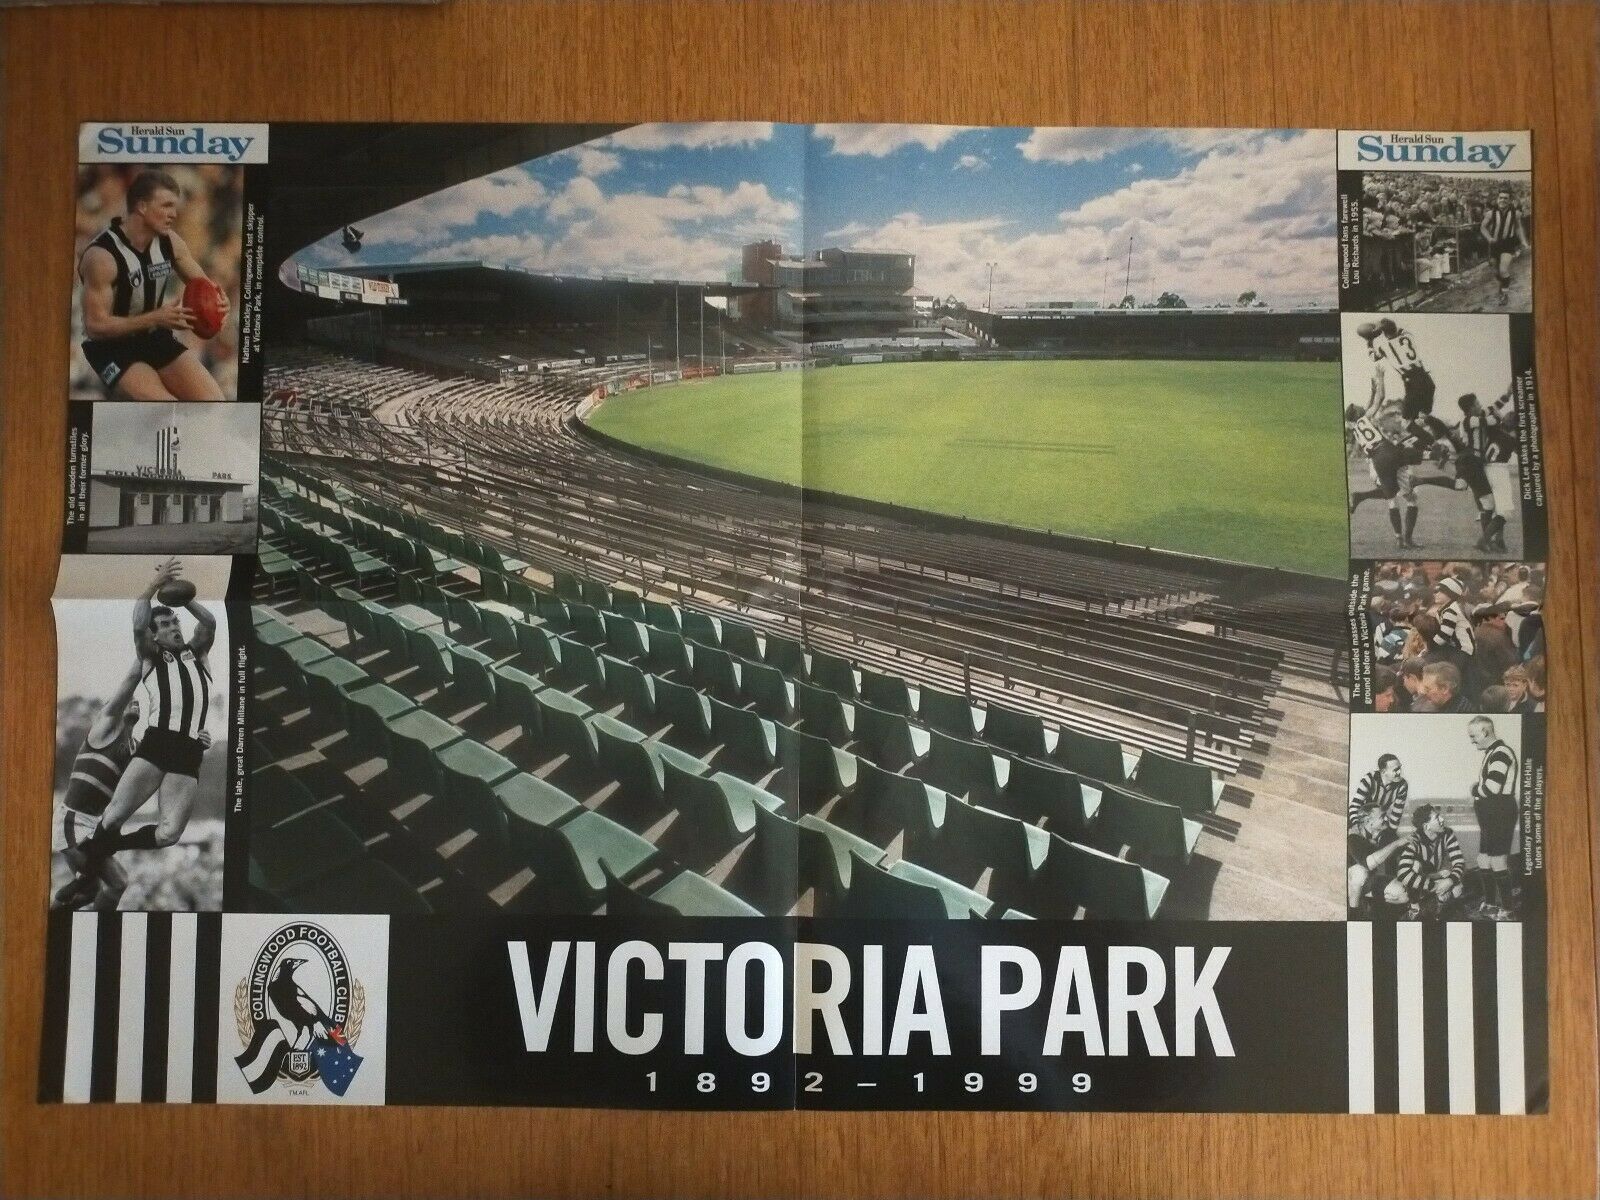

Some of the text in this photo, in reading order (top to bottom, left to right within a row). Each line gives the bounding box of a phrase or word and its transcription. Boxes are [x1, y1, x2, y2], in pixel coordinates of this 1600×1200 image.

[131, 126, 185, 136] Herald Sun
[1390, 134, 1444, 144] Herald Sun
[97, 127, 255, 162] Sunday
[1357, 135, 1516, 170] Sunday
[246, 203, 255, 230] skipper
[244, 249, 254, 299] Collingwood's
[255, 246, 264, 280] complete
[1341, 244, 1350, 289] Collingwood
[254, 292, 262, 311] Park,
[243, 302, 252, 333] Buckley,
[242, 336, 250, 364] Nathan
[1387, 335, 1417, 366] 13
[1525, 368, 1533, 390] 1914.
[1516, 376, 1525, 410] screamer
[1528, 403, 1540, 452] photographer
[69, 427, 78, 463] turnstiles
[80, 432, 89, 452] glory.
[79, 455, 87, 479] former
[1532, 462, 1539, 470] by
[1524, 483, 1532, 500] Dick
[1533, 473, 1543, 506] captured
[67, 510, 75, 525] The
[78, 513, 85, 521] in
[1362, 568, 1370, 591] game.
[1358, 594, 1368, 611] Park
[1348, 574, 1360, 698] The crowded masses outside the
[1358, 613, 1369, 640] Victoria
[238, 645, 247, 668] flight.
[238, 670, 246, 684] full
[1363, 677, 1372, 704] ground
[237, 696, 245, 725] Millane
[236, 727, 245, 753] Darren
[236, 755, 244, 776] great
[1524, 758, 1532, 788] McHale
[235, 778, 244, 795] late,
[1523, 790, 1532, 808] Jock
[234, 798, 242, 812] The
[1524, 835, 1533, 876] Legendary
[1534, 846, 1542, 869] tutors
[252, 926, 348, 1024] COLLINGWOOD FOOTBALL CLUB
[506, 940, 1236, 1057] VICTORIA PARK
[292, 1062, 308, 1070] 1892
[293, 1054, 306, 1062] EST
